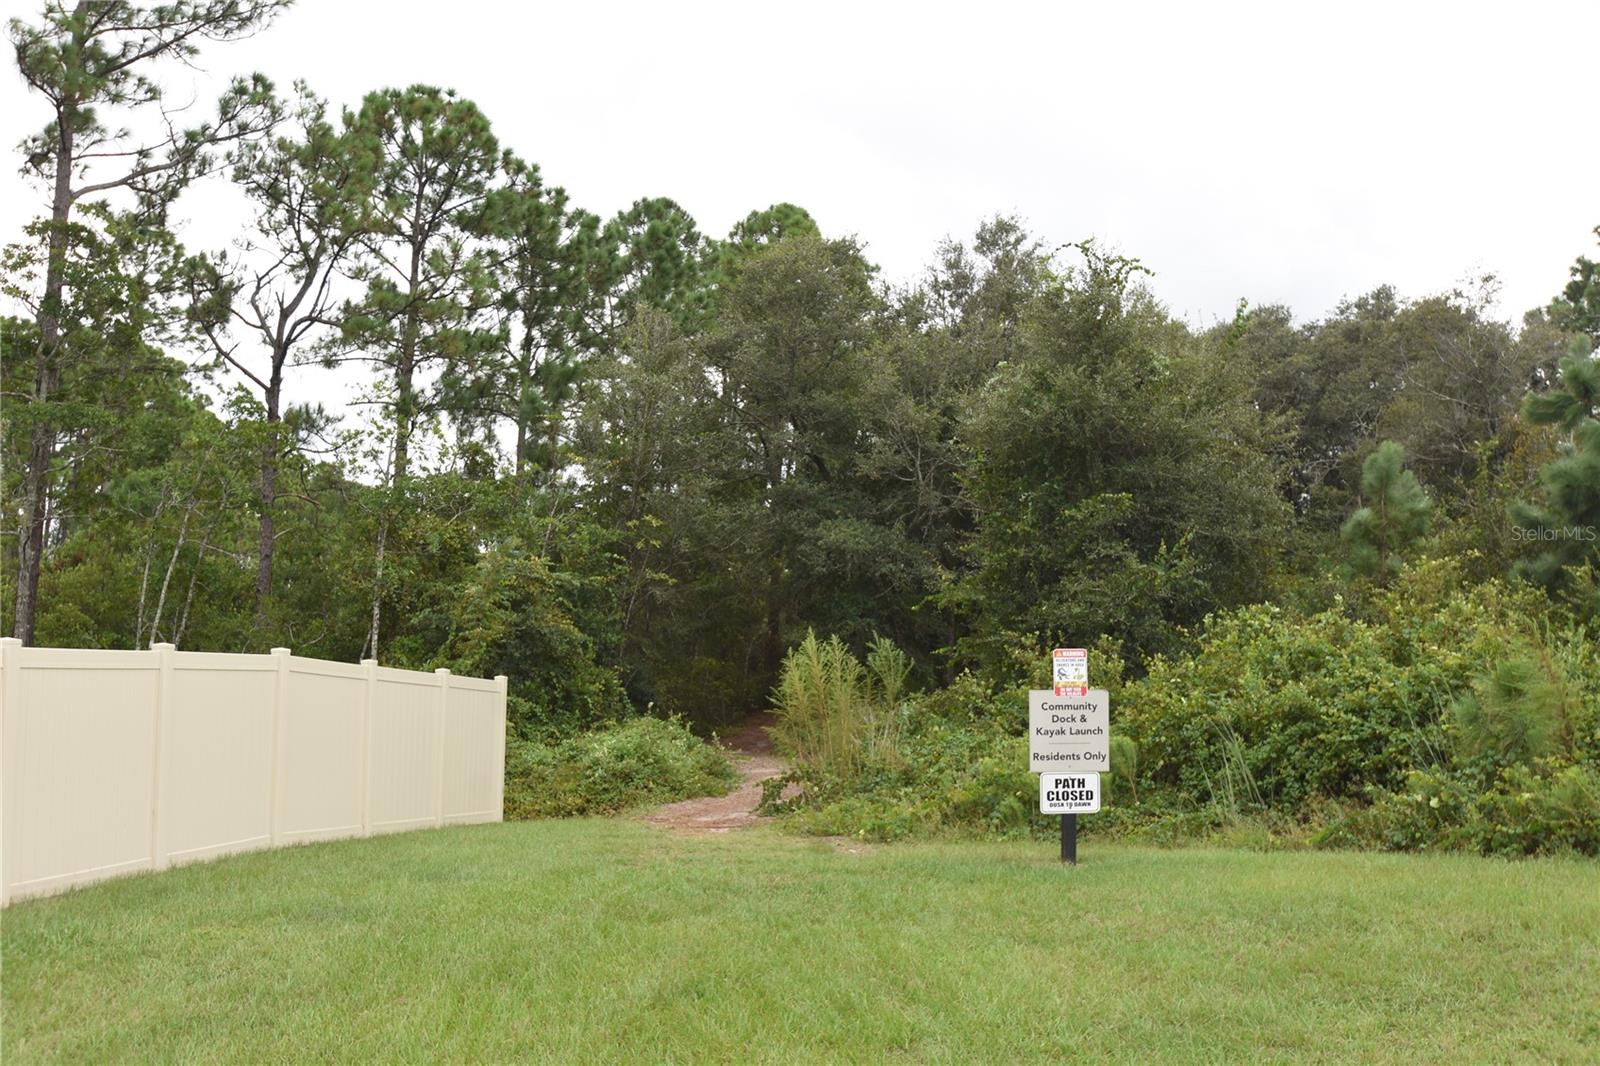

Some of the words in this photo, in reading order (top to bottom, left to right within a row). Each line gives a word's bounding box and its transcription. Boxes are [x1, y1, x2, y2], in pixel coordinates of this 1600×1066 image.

[1041, 702, 1097, 712] Community
[1052, 714, 1076, 723] Dock
[1079, 714, 1087, 723] &
[1036, 727, 1066, 738] Kayak
[1070, 726, 1103, 735] Launch
[1033, 752, 1080, 761] Residents
[1084, 752, 1106, 762] Only
[1054, 778, 1086, 788] PATH
[1046, 790, 1094, 801] CLOSED
